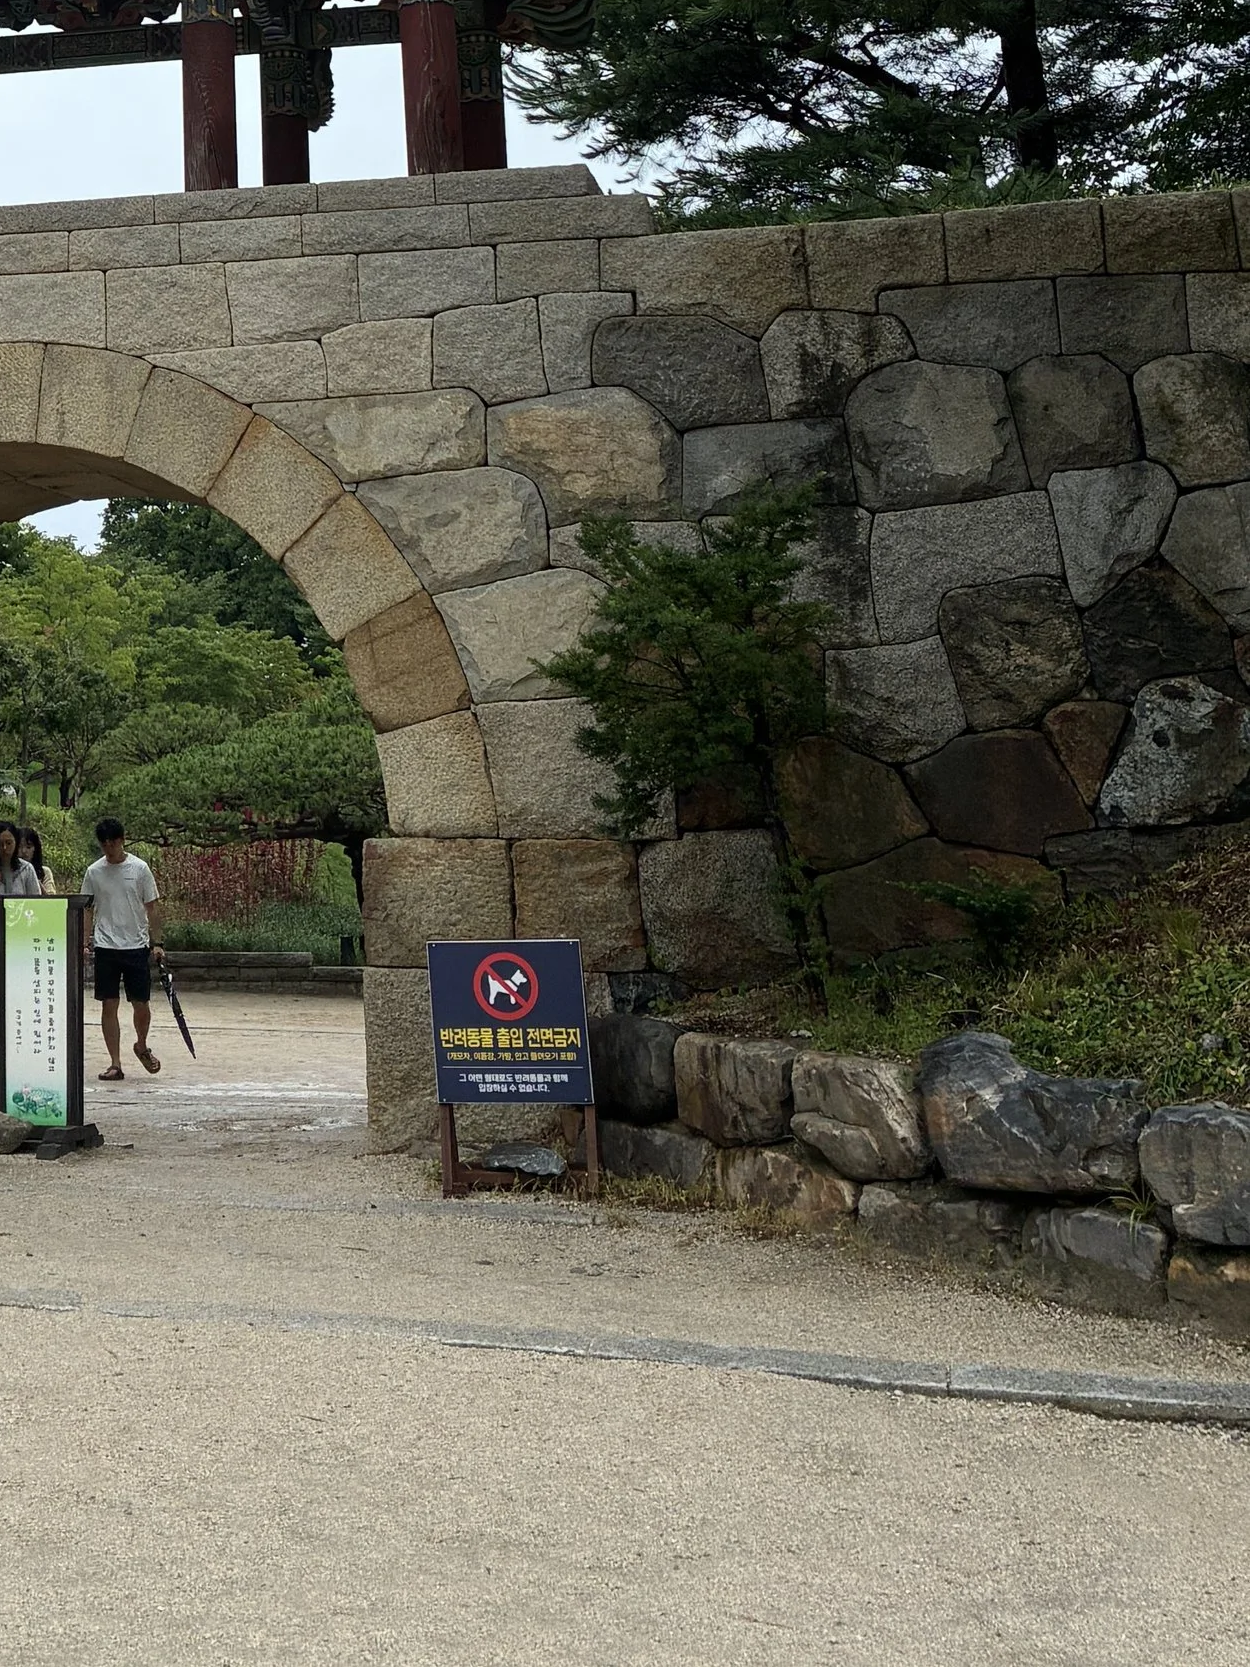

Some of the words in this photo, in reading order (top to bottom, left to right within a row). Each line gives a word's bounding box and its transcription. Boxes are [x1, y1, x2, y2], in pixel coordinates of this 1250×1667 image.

[440, 1027, 494, 1048] 반려동물
[496, 1027, 524, 1048] 출입
[526, 1027, 581, 1048] 전면금지
[459, 1073, 467, 1082] 그
[509, 1084, 517, 1092] 수
